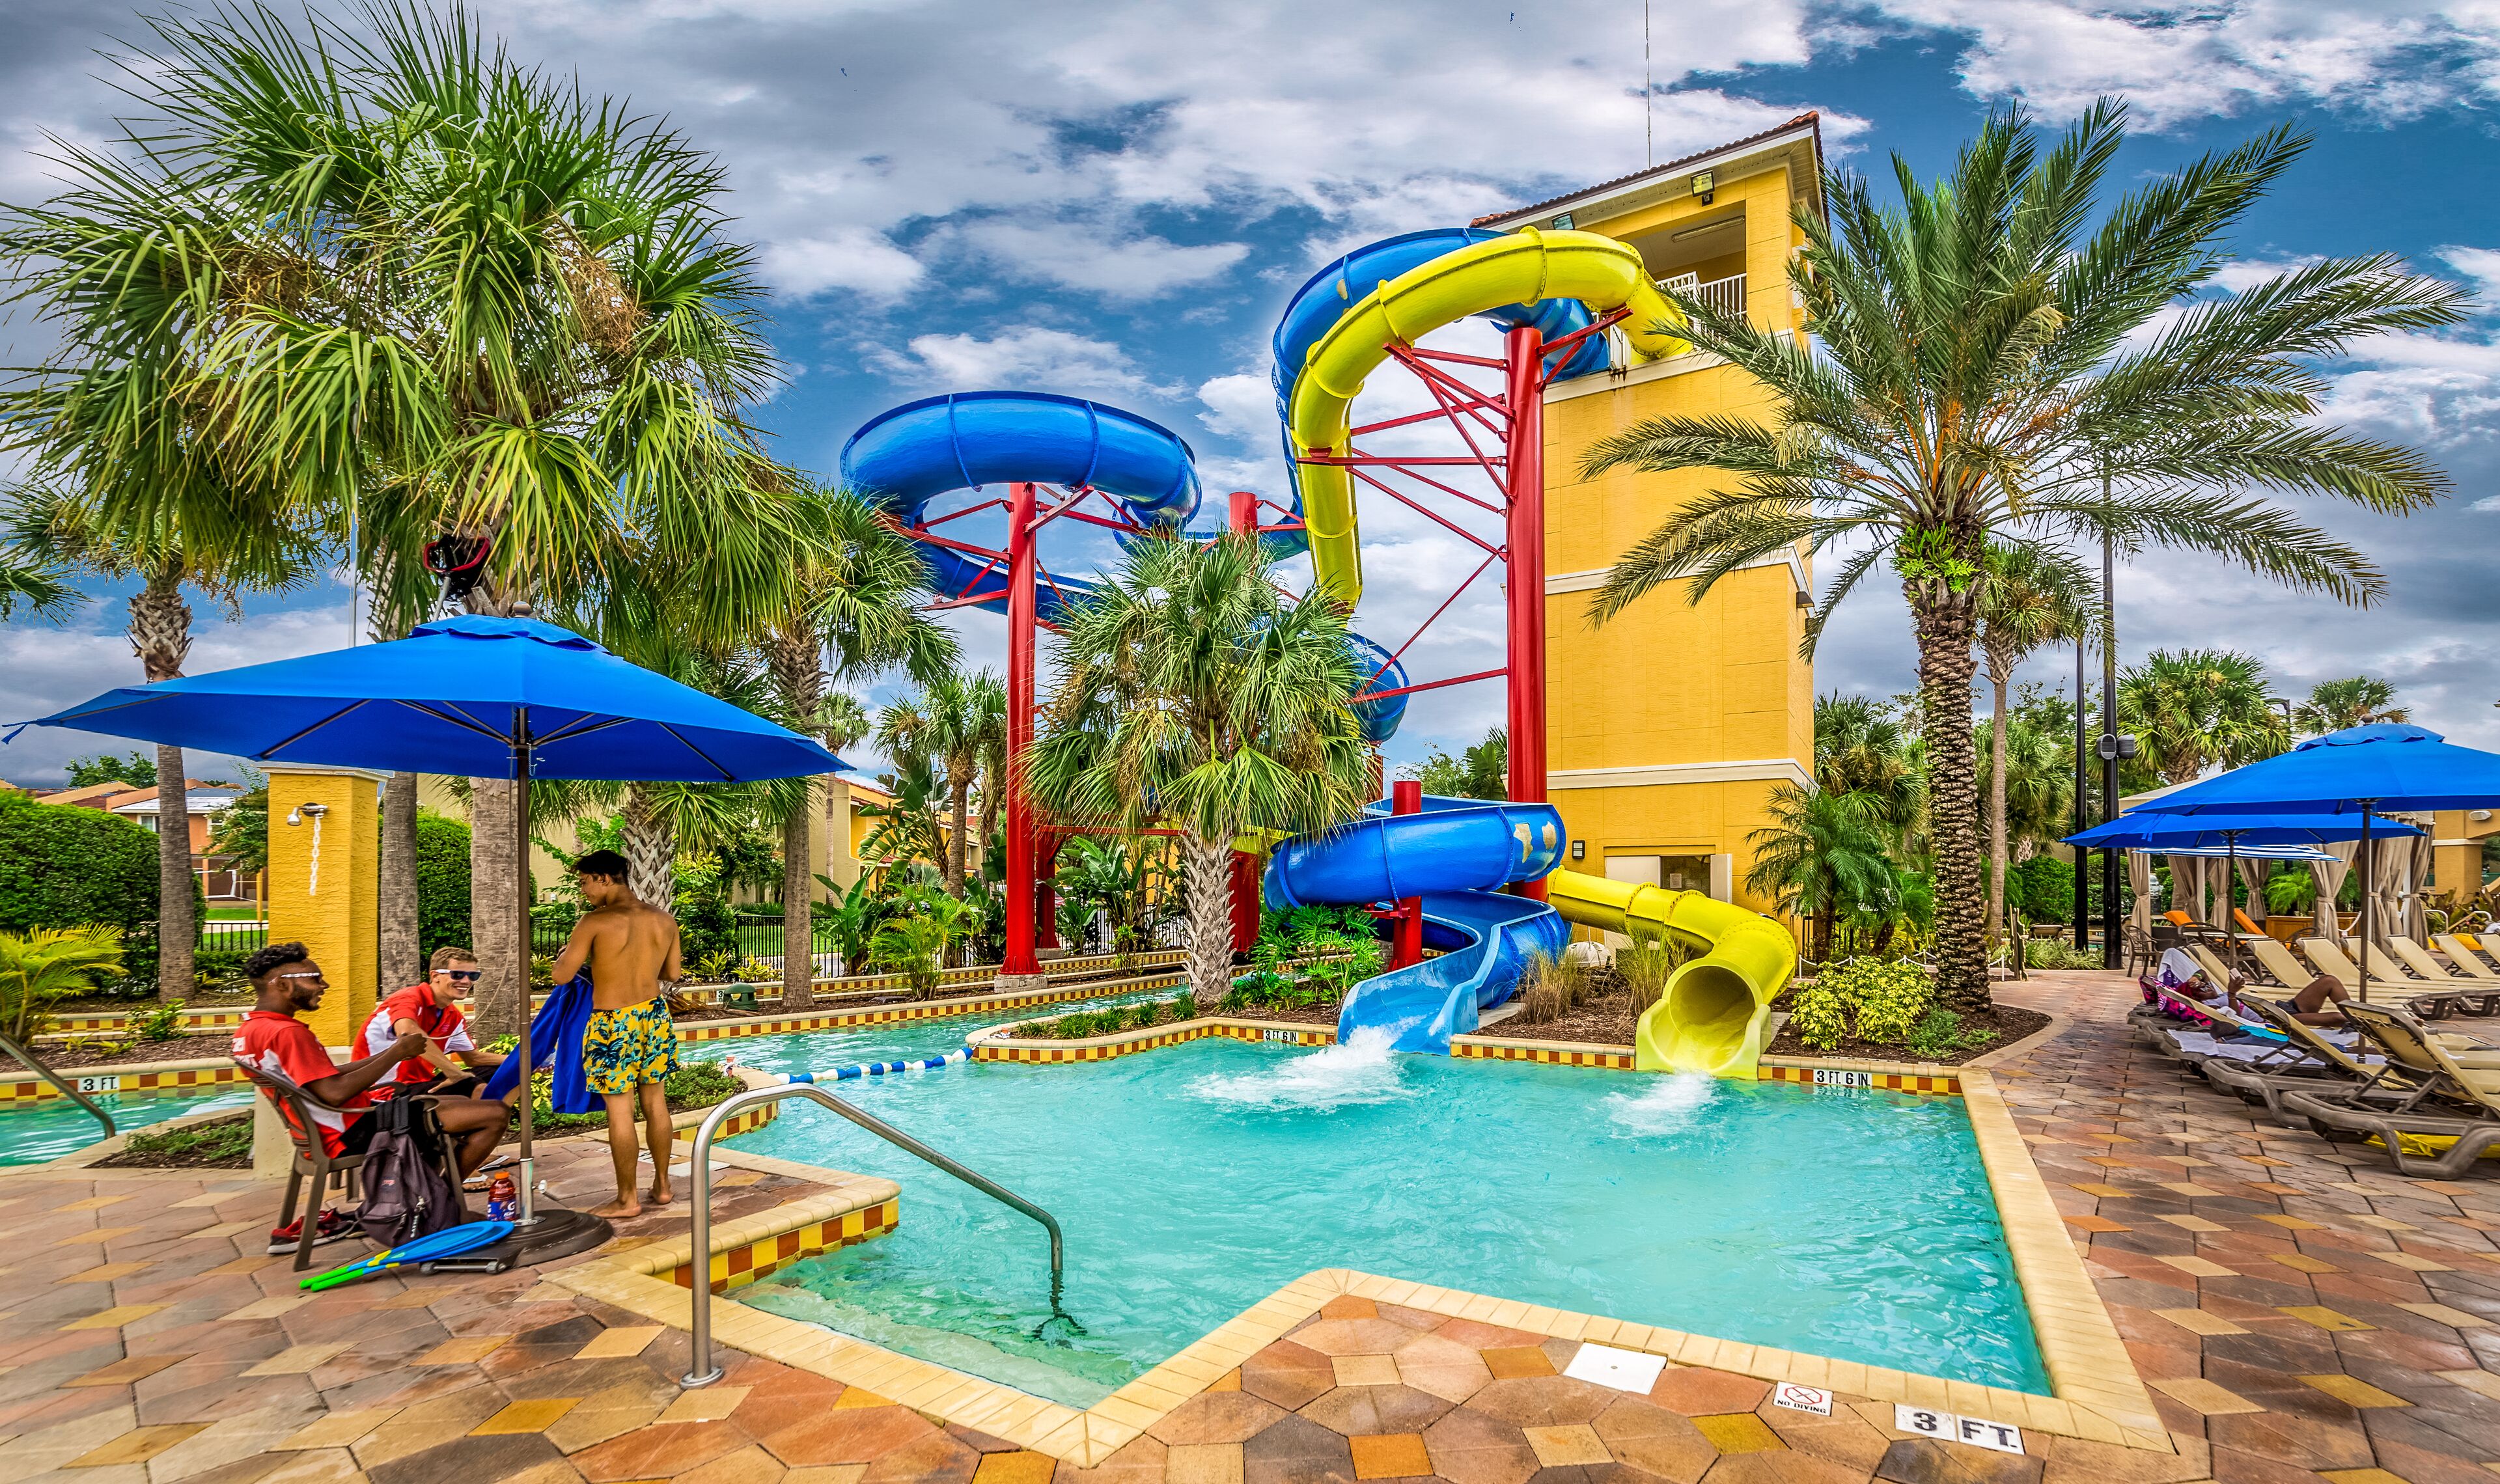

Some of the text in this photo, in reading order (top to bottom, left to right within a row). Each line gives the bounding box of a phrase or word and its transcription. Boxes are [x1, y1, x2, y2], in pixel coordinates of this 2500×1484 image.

[1266, 1030, 1271, 1041] 3
[1283, 1032, 1288, 1040] 6
[84, 1077, 117, 1091] 3 FT.
[1817, 1071, 1870, 1086] 3 FT. 6 IN.
[1794, 1403, 1826, 1414] DIVING
[1913, 1412, 2018, 1448] 3 FT.
